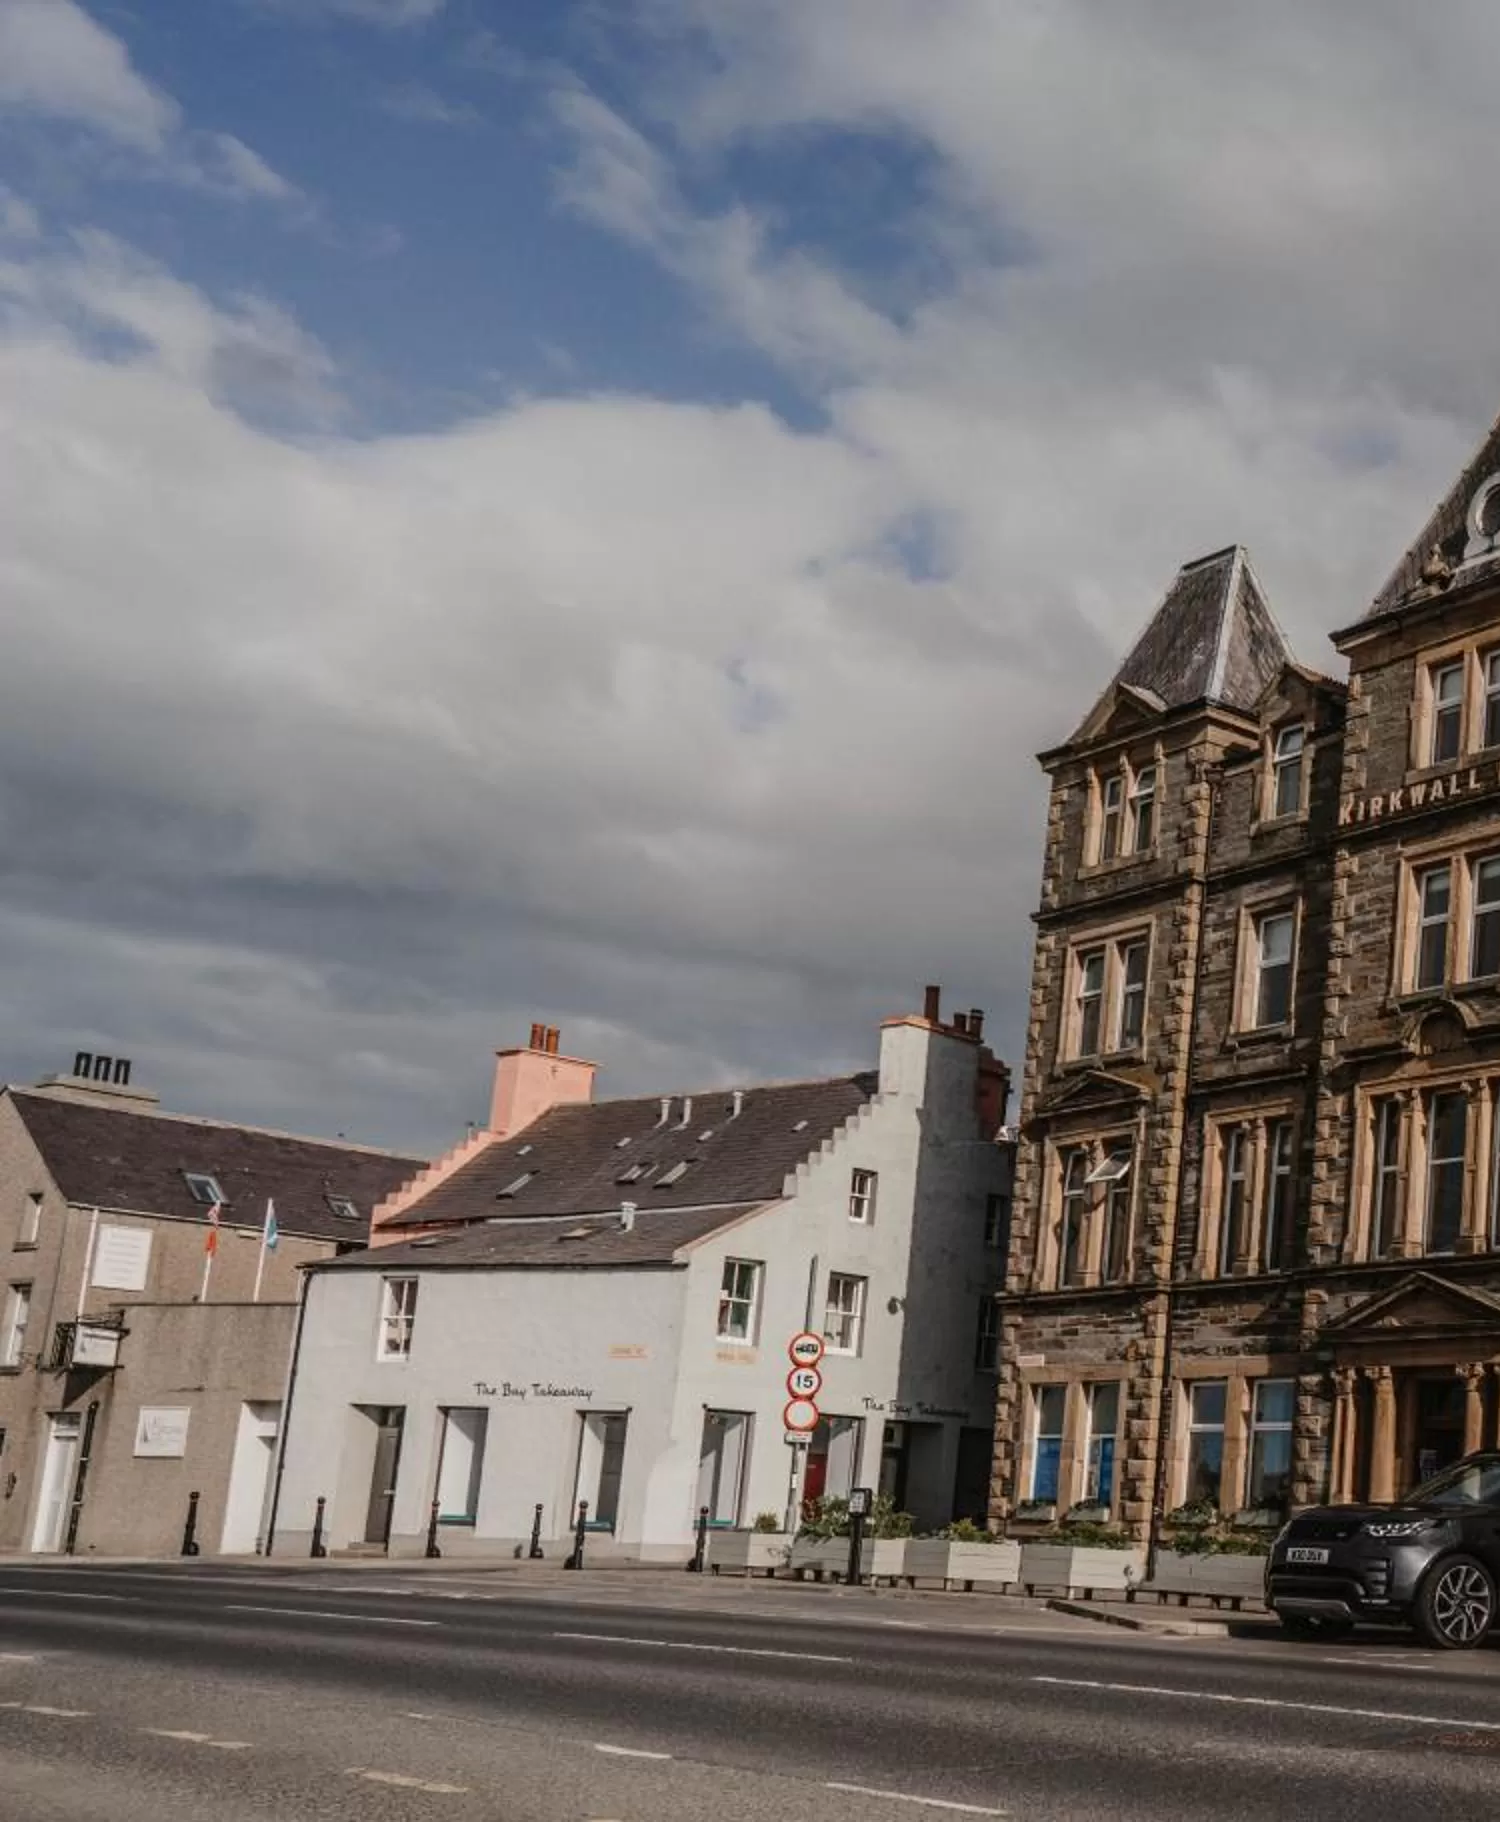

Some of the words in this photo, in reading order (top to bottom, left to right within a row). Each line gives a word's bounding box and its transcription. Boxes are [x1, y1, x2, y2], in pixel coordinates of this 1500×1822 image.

[1338, 769, 1481, 826] KIRKWALL
[796, 1374, 814, 1389] 15
[473, 1382, 497, 1397] The
